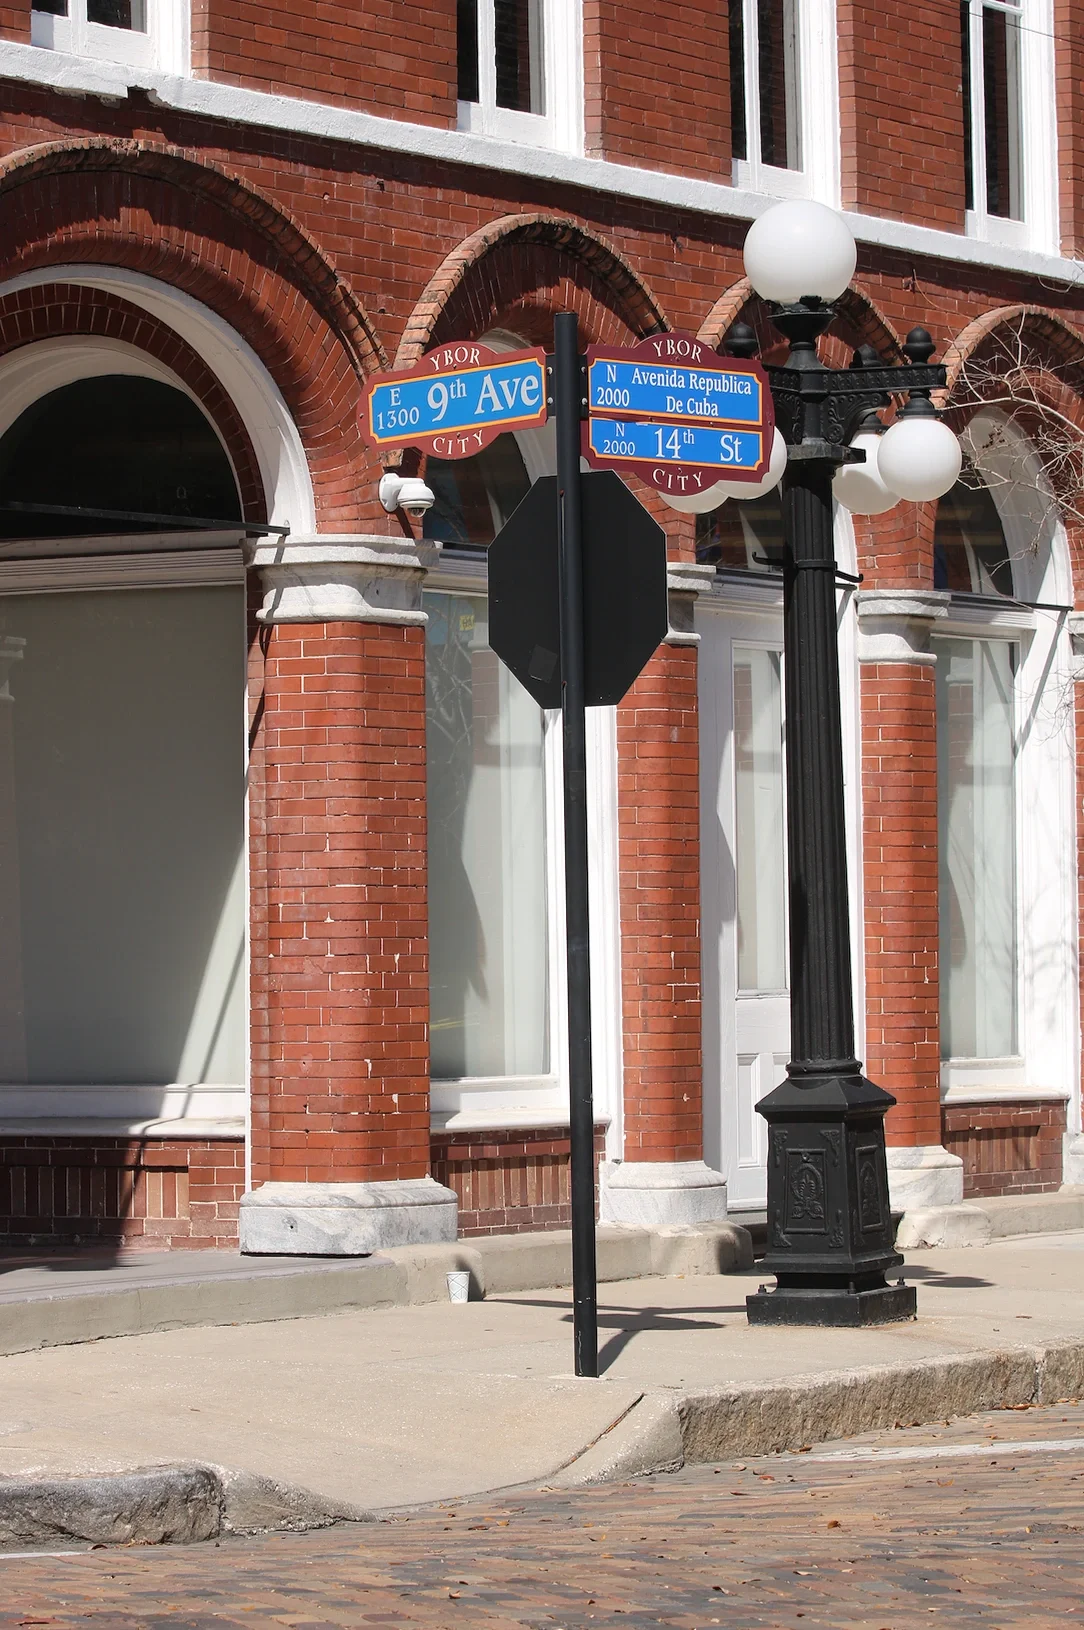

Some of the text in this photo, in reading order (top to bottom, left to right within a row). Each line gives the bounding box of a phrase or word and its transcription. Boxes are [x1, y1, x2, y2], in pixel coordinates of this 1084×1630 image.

[430, 347, 480, 371] YBOR
[653, 339, 701, 363] YBOR
[607, 365, 616, 382] N
[632, 368, 751, 396] Avenida Republica
[390, 388, 400, 406] E
[427, 373, 539, 422] 9th Ave
[597, 387, 629, 406] 2000
[666, 396, 718, 416] De Cuba
[377, 407, 419, 430] 1300
[616, 423, 624, 437] N
[433, 430, 483, 455] CITY
[604, 440, 635, 454] 2000
[654, 428, 742, 462] 14th St
[653, 469, 702, 490] CITY
